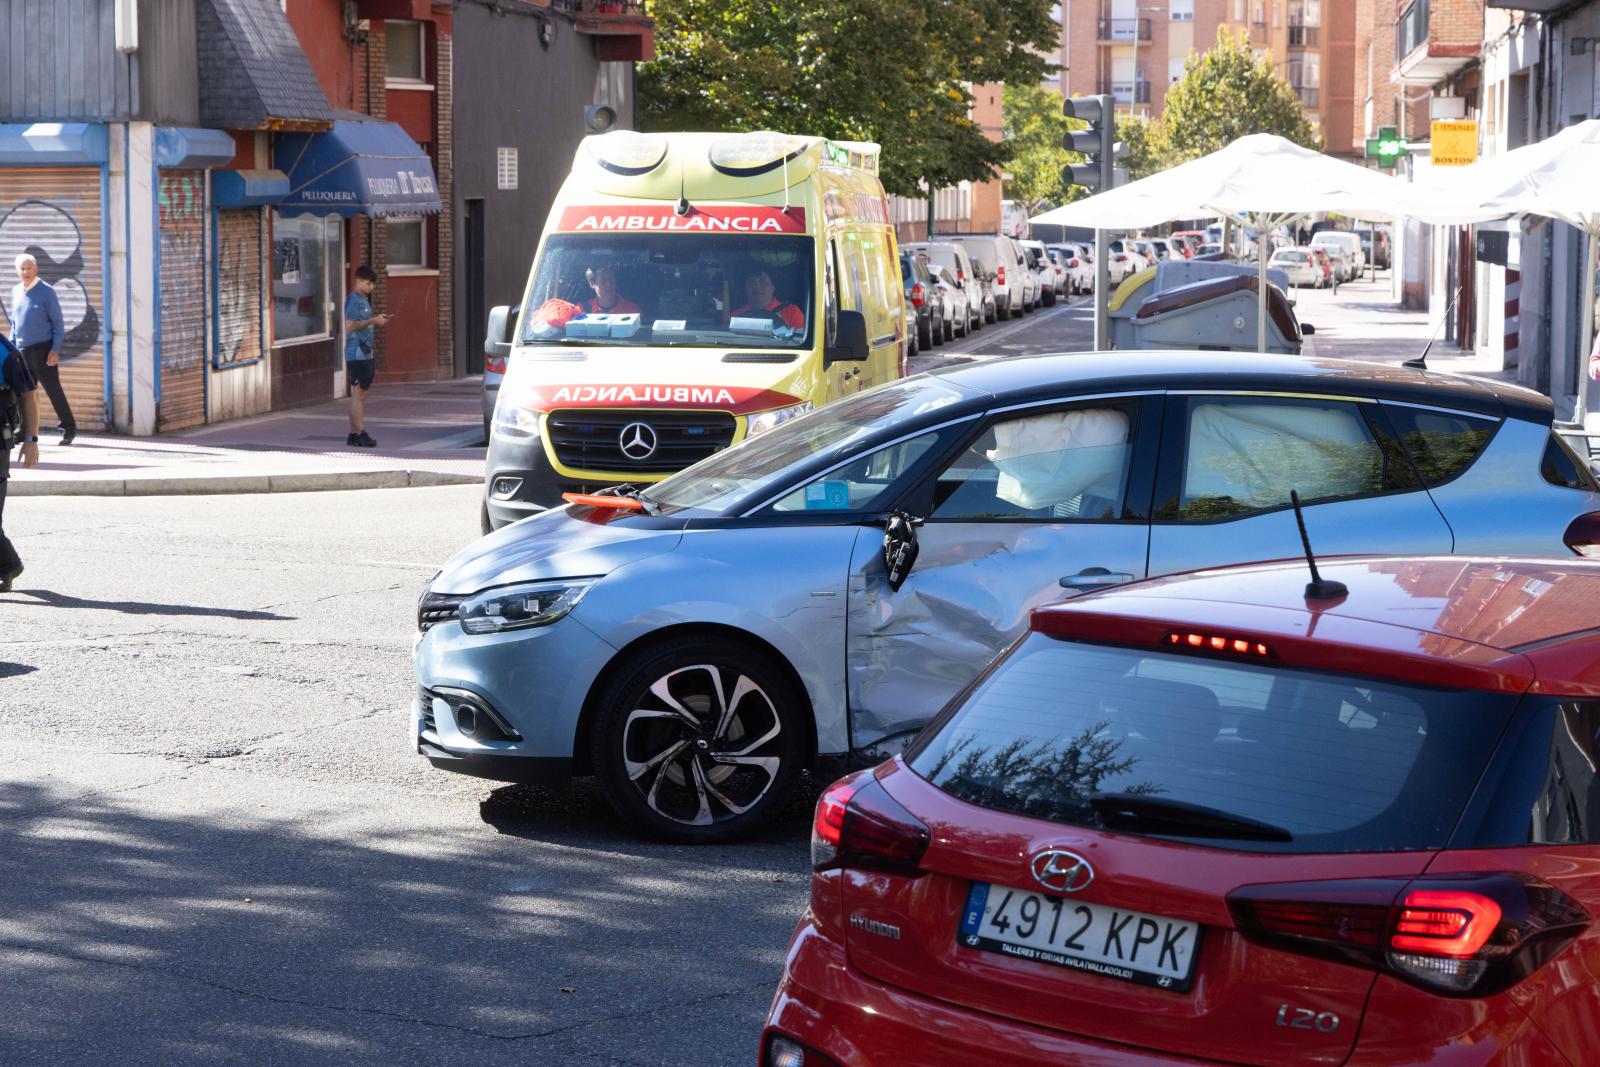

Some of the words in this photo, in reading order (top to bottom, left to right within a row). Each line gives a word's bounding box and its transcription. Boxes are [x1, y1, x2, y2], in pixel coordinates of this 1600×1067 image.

[1434, 156, 1473, 164] BOSTON
[302, 190, 357, 200] PELUQUERIA
[575, 215, 783, 232] AMBULANCIA
[850, 912, 900, 940] HYUNDAI
[967, 911, 978, 925] E
[990, 890, 1094, 952] 4912
[1103, 911, 1189, 972] KPK
[1002, 943, 1035, 957] TALLERES
[1035, 951, 1041, 959] Y
[1041, 952, 1064, 964] GRUAS
[1065, 957, 1085, 969] AVILA
